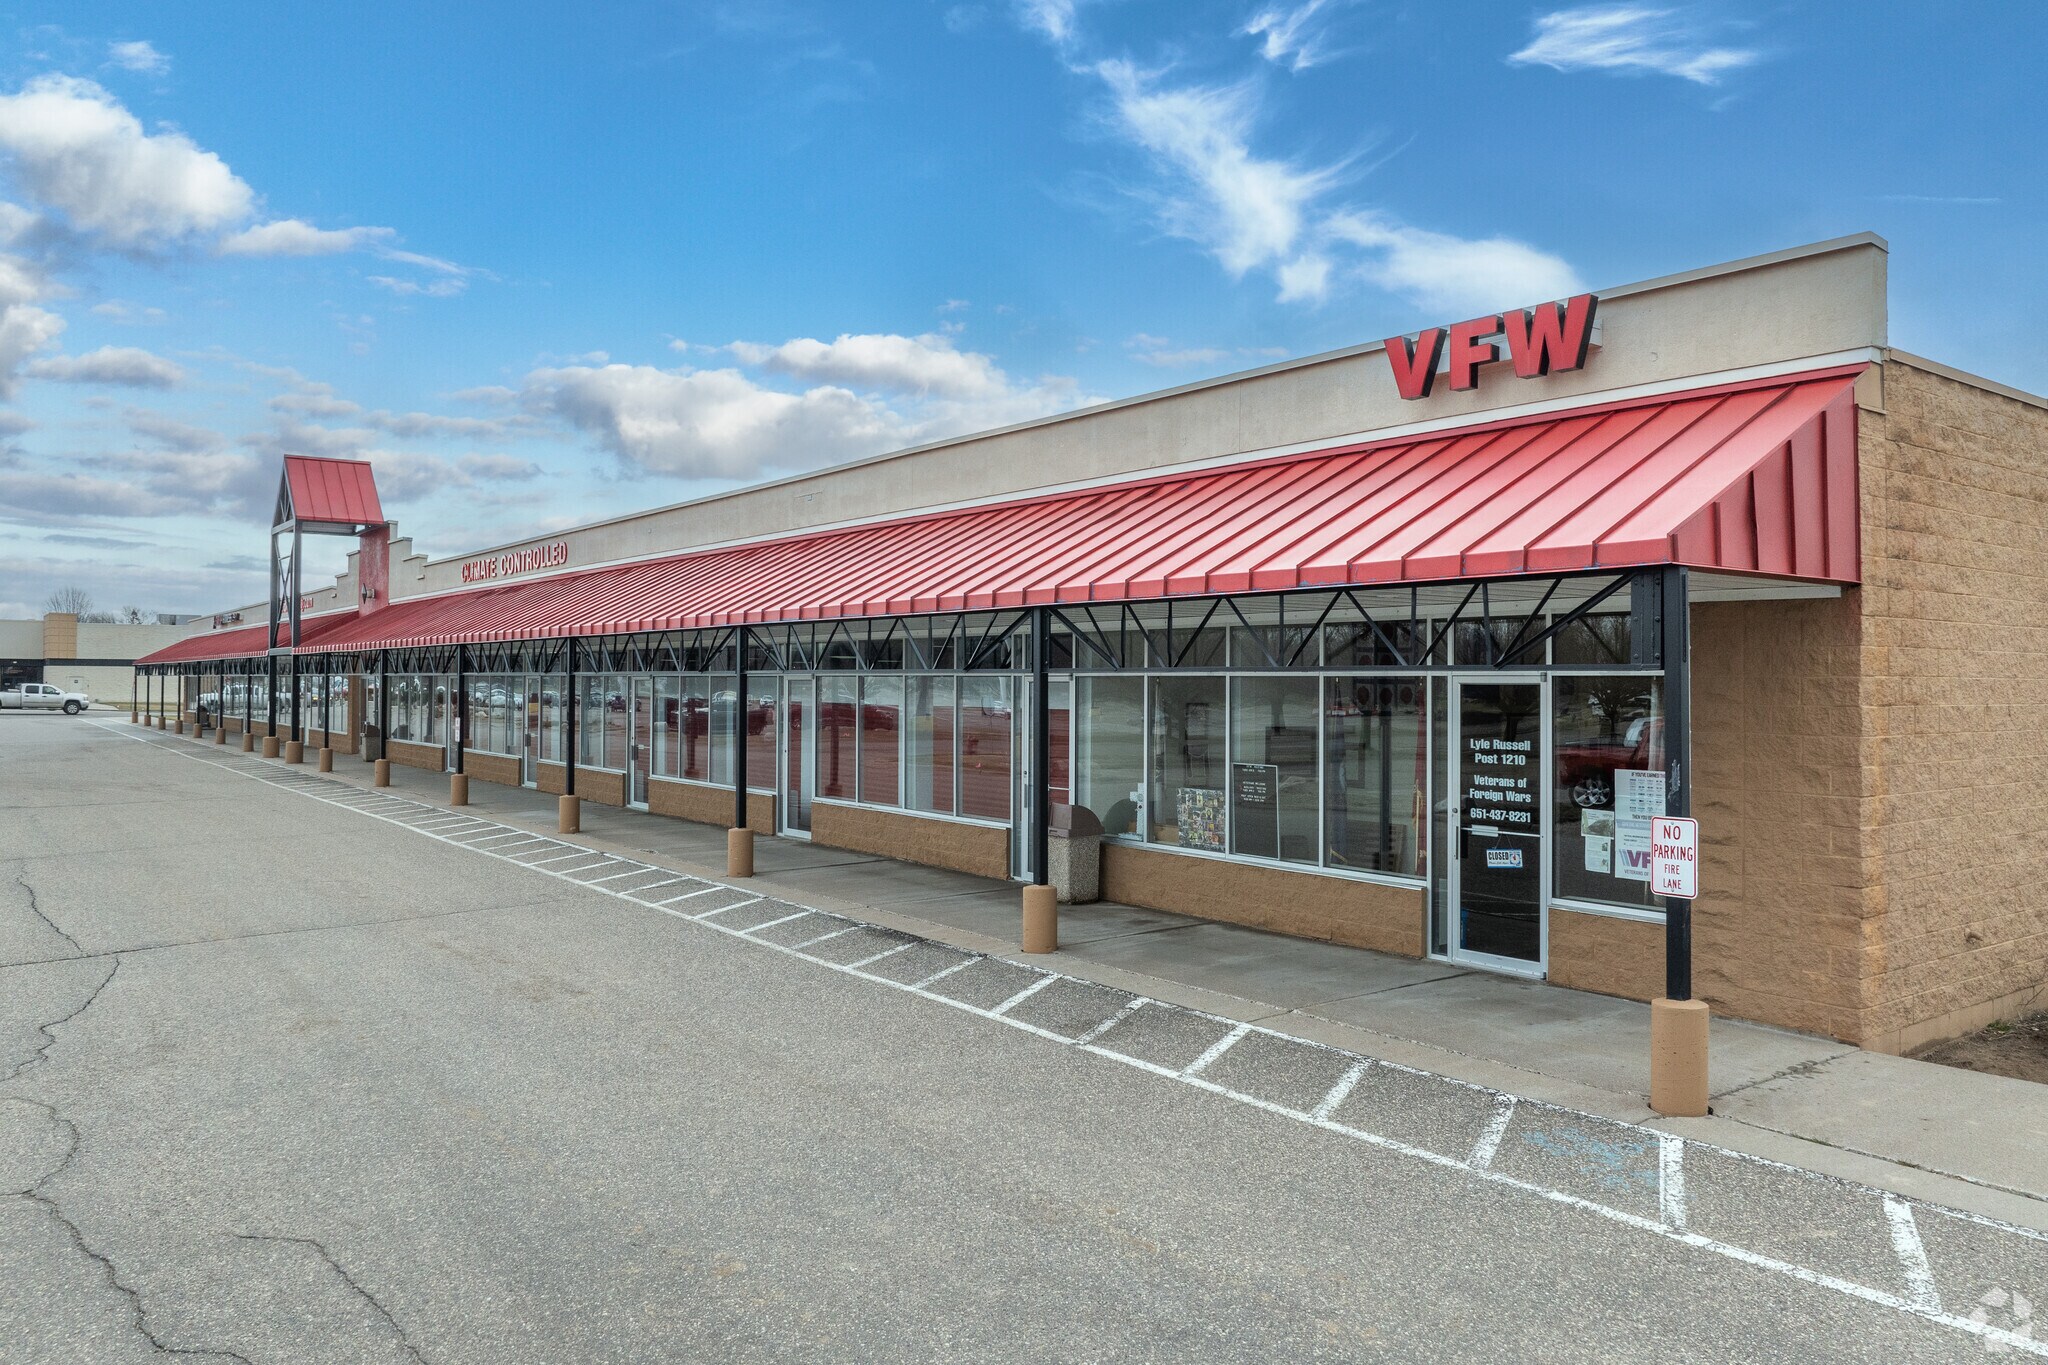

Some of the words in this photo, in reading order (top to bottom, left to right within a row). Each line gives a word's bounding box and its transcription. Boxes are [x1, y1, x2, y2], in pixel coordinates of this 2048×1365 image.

[1384, 293, 1598, 400] VFW
[461, 556, 498, 583] CLIMATE
[500, 541, 568, 576] CONTROLLED
[1470, 738, 1490, 750] Lyle
[1493, 739, 1531, 751] Russell
[1474, 752, 1498, 764] Post
[1501, 754, 1526, 766] 1210
[1474, 774, 1515, 788] Veterans
[1517, 777, 1527, 788] of
[1469, 788, 1503, 802] Foreign
[1506, 790, 1532, 803] Wars
[1470, 807, 1531, 823] 651-437-8231
[1663, 825, 1681, 840] NO
[1488, 851, 1509, 861] CLOSED
[1627, 849, 1651, 869] VF
[1653, 843, 1693, 862] PARKING
[1664, 863, 1680, 875] FIRE
[1663, 878, 1682, 890] LANE
